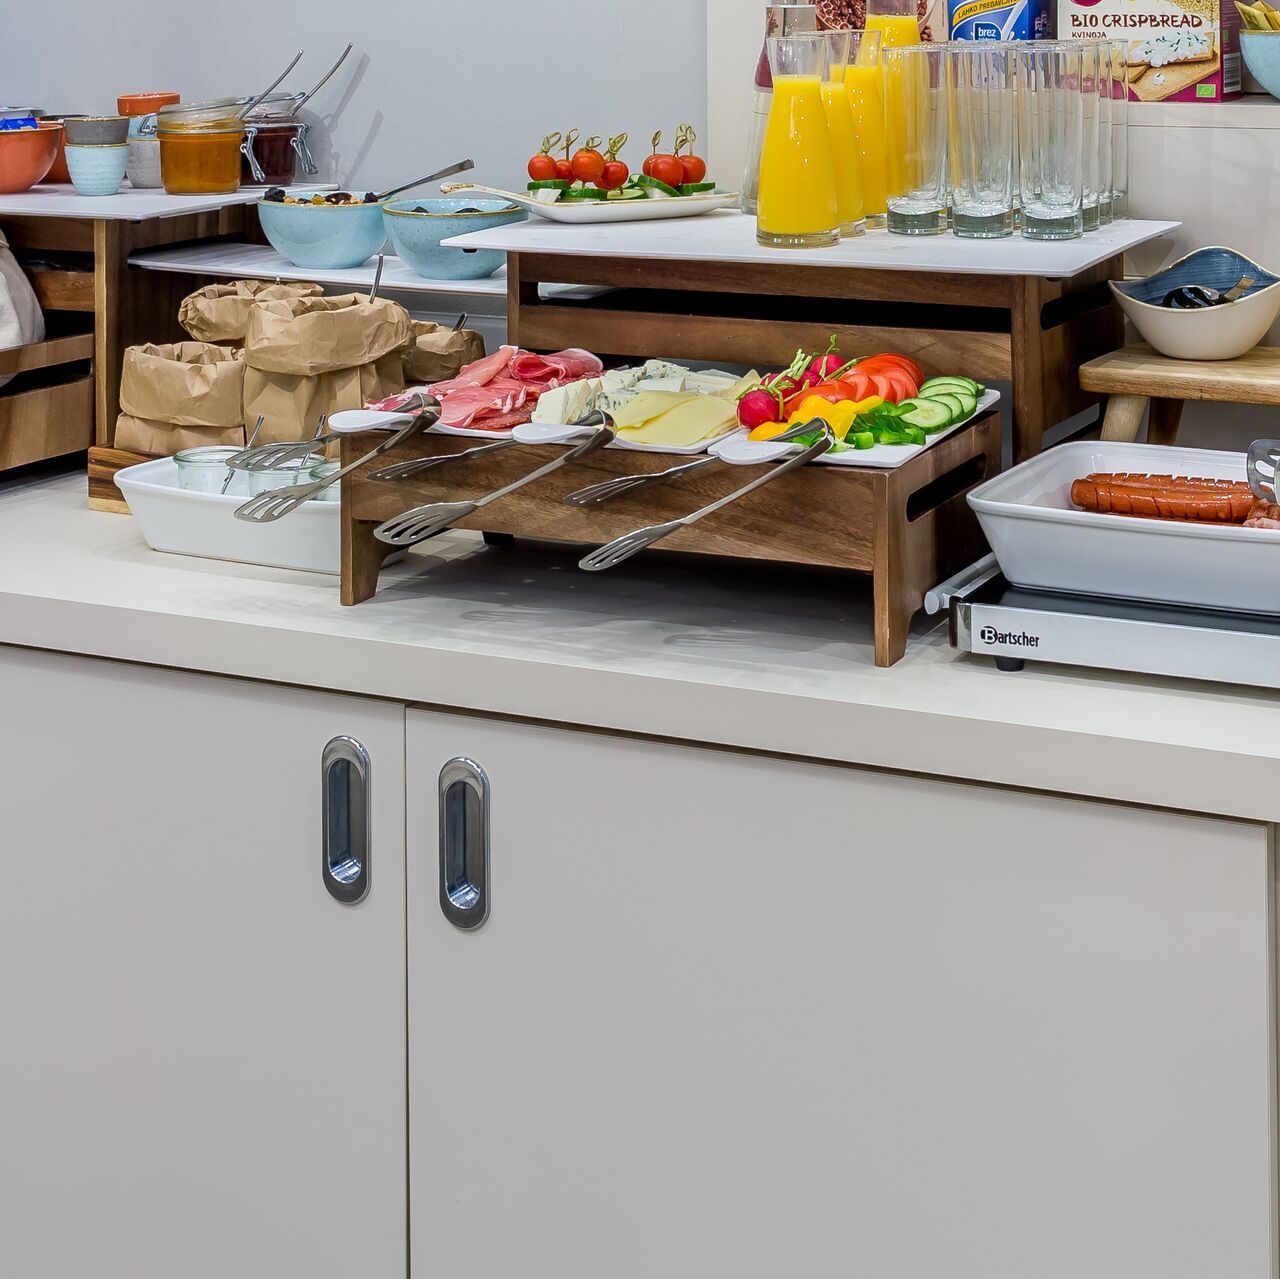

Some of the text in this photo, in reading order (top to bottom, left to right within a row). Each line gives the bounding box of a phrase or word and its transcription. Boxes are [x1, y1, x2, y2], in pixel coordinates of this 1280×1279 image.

[958, 4, 979, 19] LAHKO
[1070, 13, 1099, 28] BIO
[1102, 13, 1203, 29] CRISPBREAD
[977, 26, 997, 37] brez
[1071, 31, 1107, 39] KVINOJA
[980, 625, 1040, 647] Bartscher
